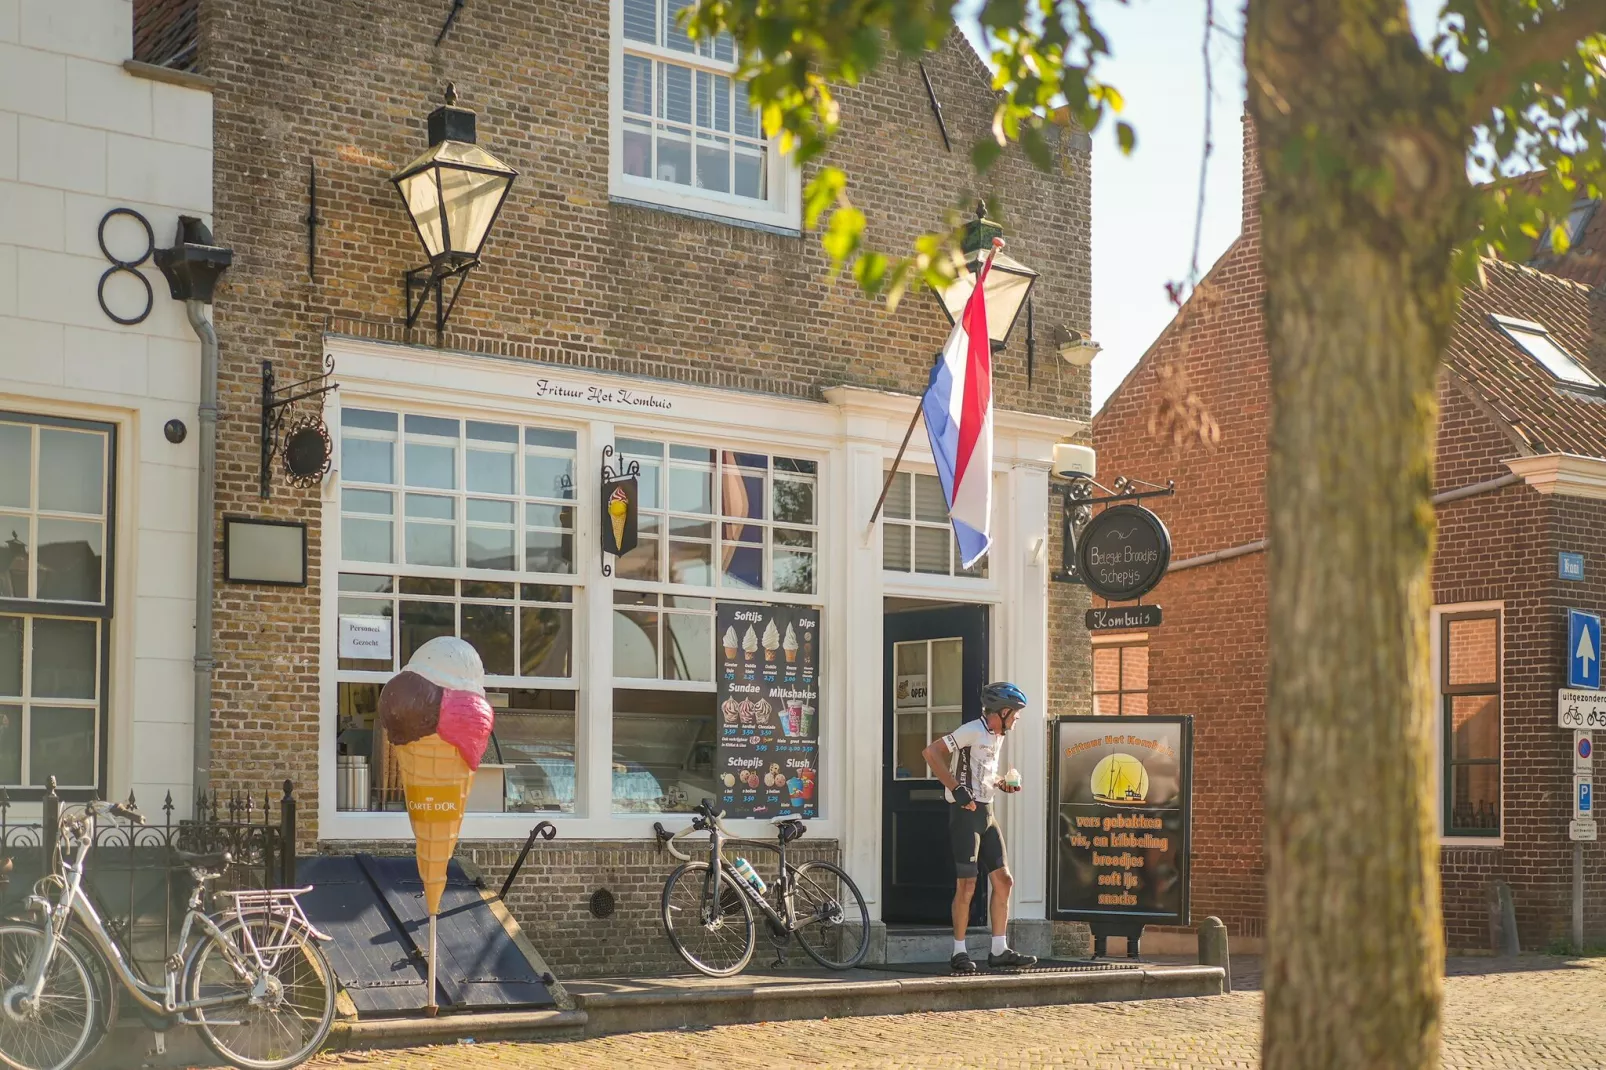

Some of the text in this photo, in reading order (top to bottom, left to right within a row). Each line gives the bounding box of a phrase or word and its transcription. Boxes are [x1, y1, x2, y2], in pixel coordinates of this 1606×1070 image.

[536, 379, 672, 409] Frituur Het Kombuis
[1091, 545, 1158, 566] Belegde Broodjes
[1100, 568, 1140, 587] Schepijs
[734, 611, 763, 623] Softijs
[1093, 611, 1151, 629] Kombuis
[350, 624, 380, 633] Personeel
[799, 618, 816, 629] Dips
[352, 638, 379, 646] Gezocht
[728, 683, 761, 693] Sundae
[769, 688, 817, 699] Milkshakes
[911, 687, 928, 698] OPEN
[1105, 734, 1125, 745] Het
[727, 757, 763, 769] Schepijs
[786, 758, 810, 768] Slush
[409, 800, 432, 811] CARTE
[1076, 814, 1162, 831] vers gebakken
[1070, 832, 1169, 852] vis, en kibbeling
[1092, 851, 1144, 870] broodjes
[1098, 871, 1138, 889] soft ijs
[1098, 890, 1138, 905] snacks
